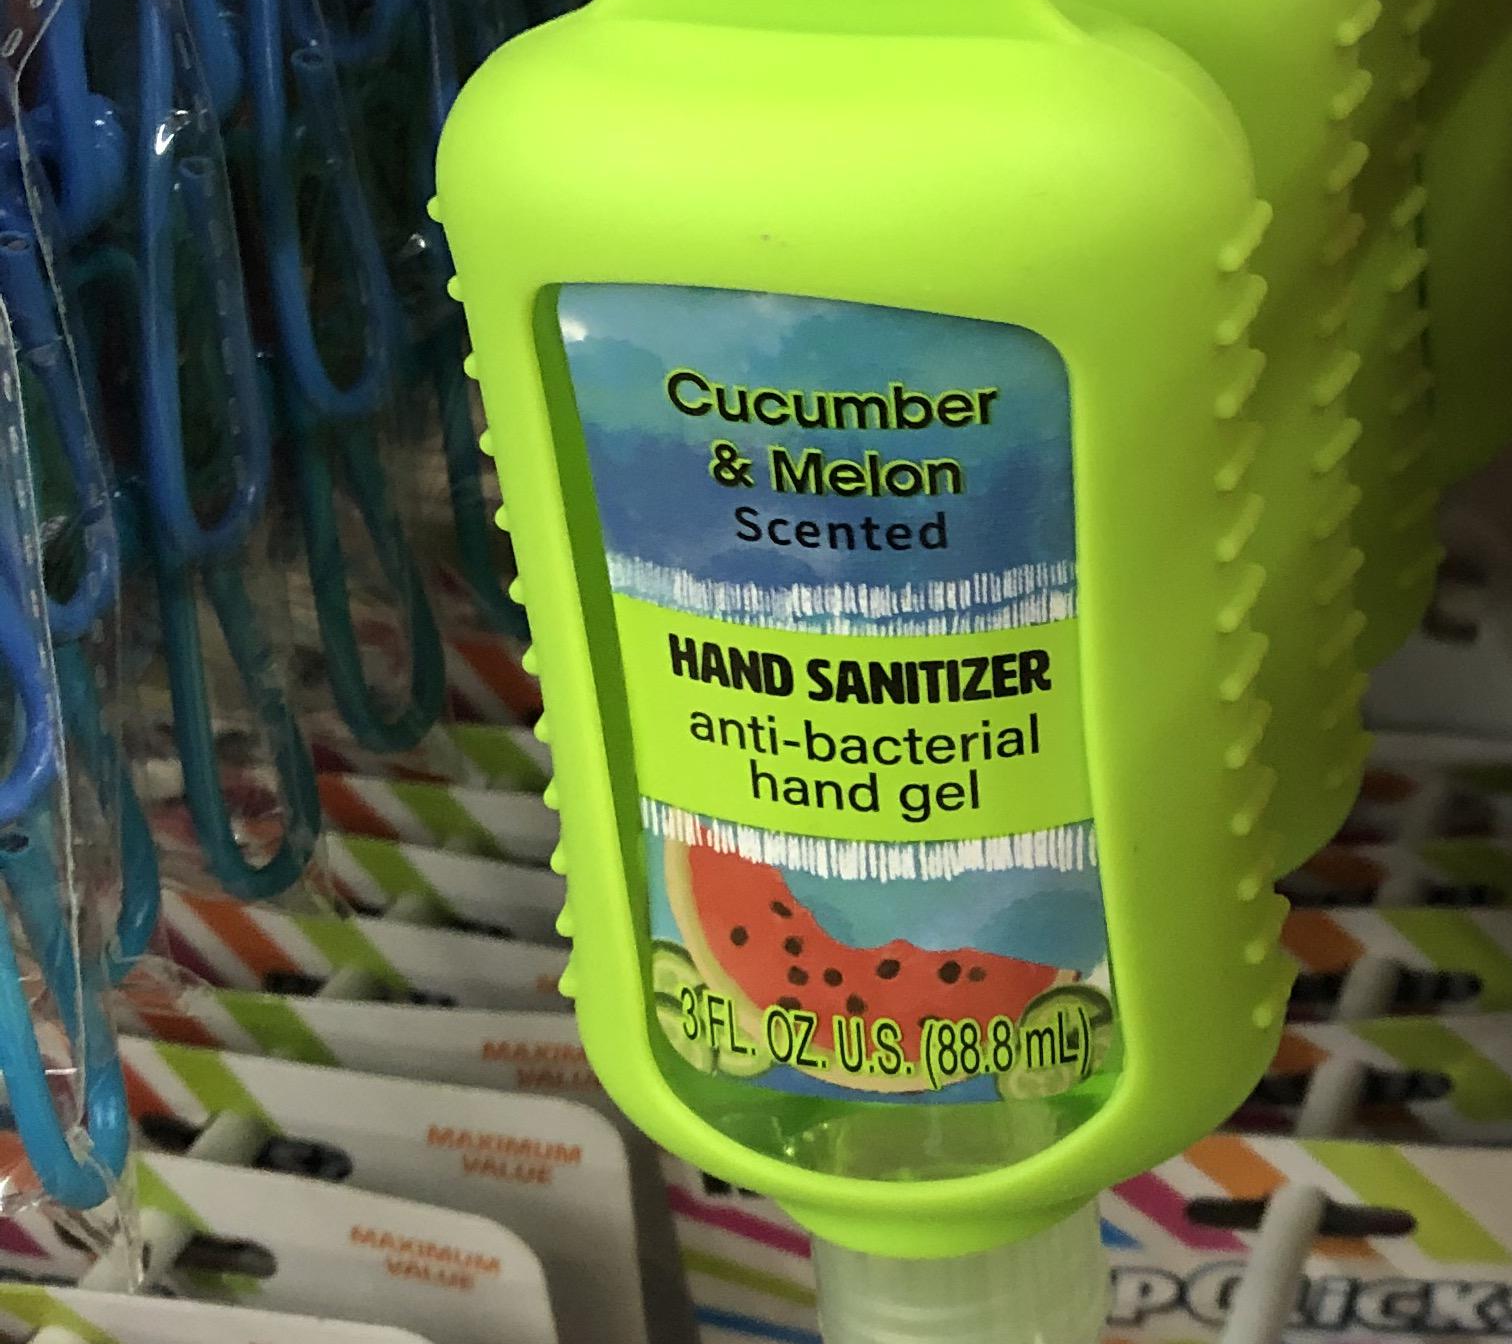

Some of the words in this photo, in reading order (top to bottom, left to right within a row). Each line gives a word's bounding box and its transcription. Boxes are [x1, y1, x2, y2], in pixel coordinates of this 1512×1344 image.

[665, 369, 998, 430] Cucumber
[711, 442, 754, 488] &
[770, 448, 964, 497] Melon
[734, 507, 949, 551] Scented
[669, 633, 794, 697] HAND
[807, 649, 1052, 705] SANITIZER
[689, 710, 1041, 766] anti-bacterial
[751, 759, 880, 812] hand
[899, 770, 980, 824] gel
[681, 987, 699, 1042] 3
[708, 995, 757, 1056] FL.
[767, 1009, 827, 1068] OZ.
[833, 1017, 912, 1075] U.S.
[922, 1017, 1013, 1090] (88.8
[1025, 1006, 1092, 1076] mL)
[425, 1123, 582, 1167] MAXIMUM
[461, 1153, 553, 1186] VALUE
[349, 1224, 501, 1274] MAXIMUM
[385, 1255, 474, 1291] VALUE
